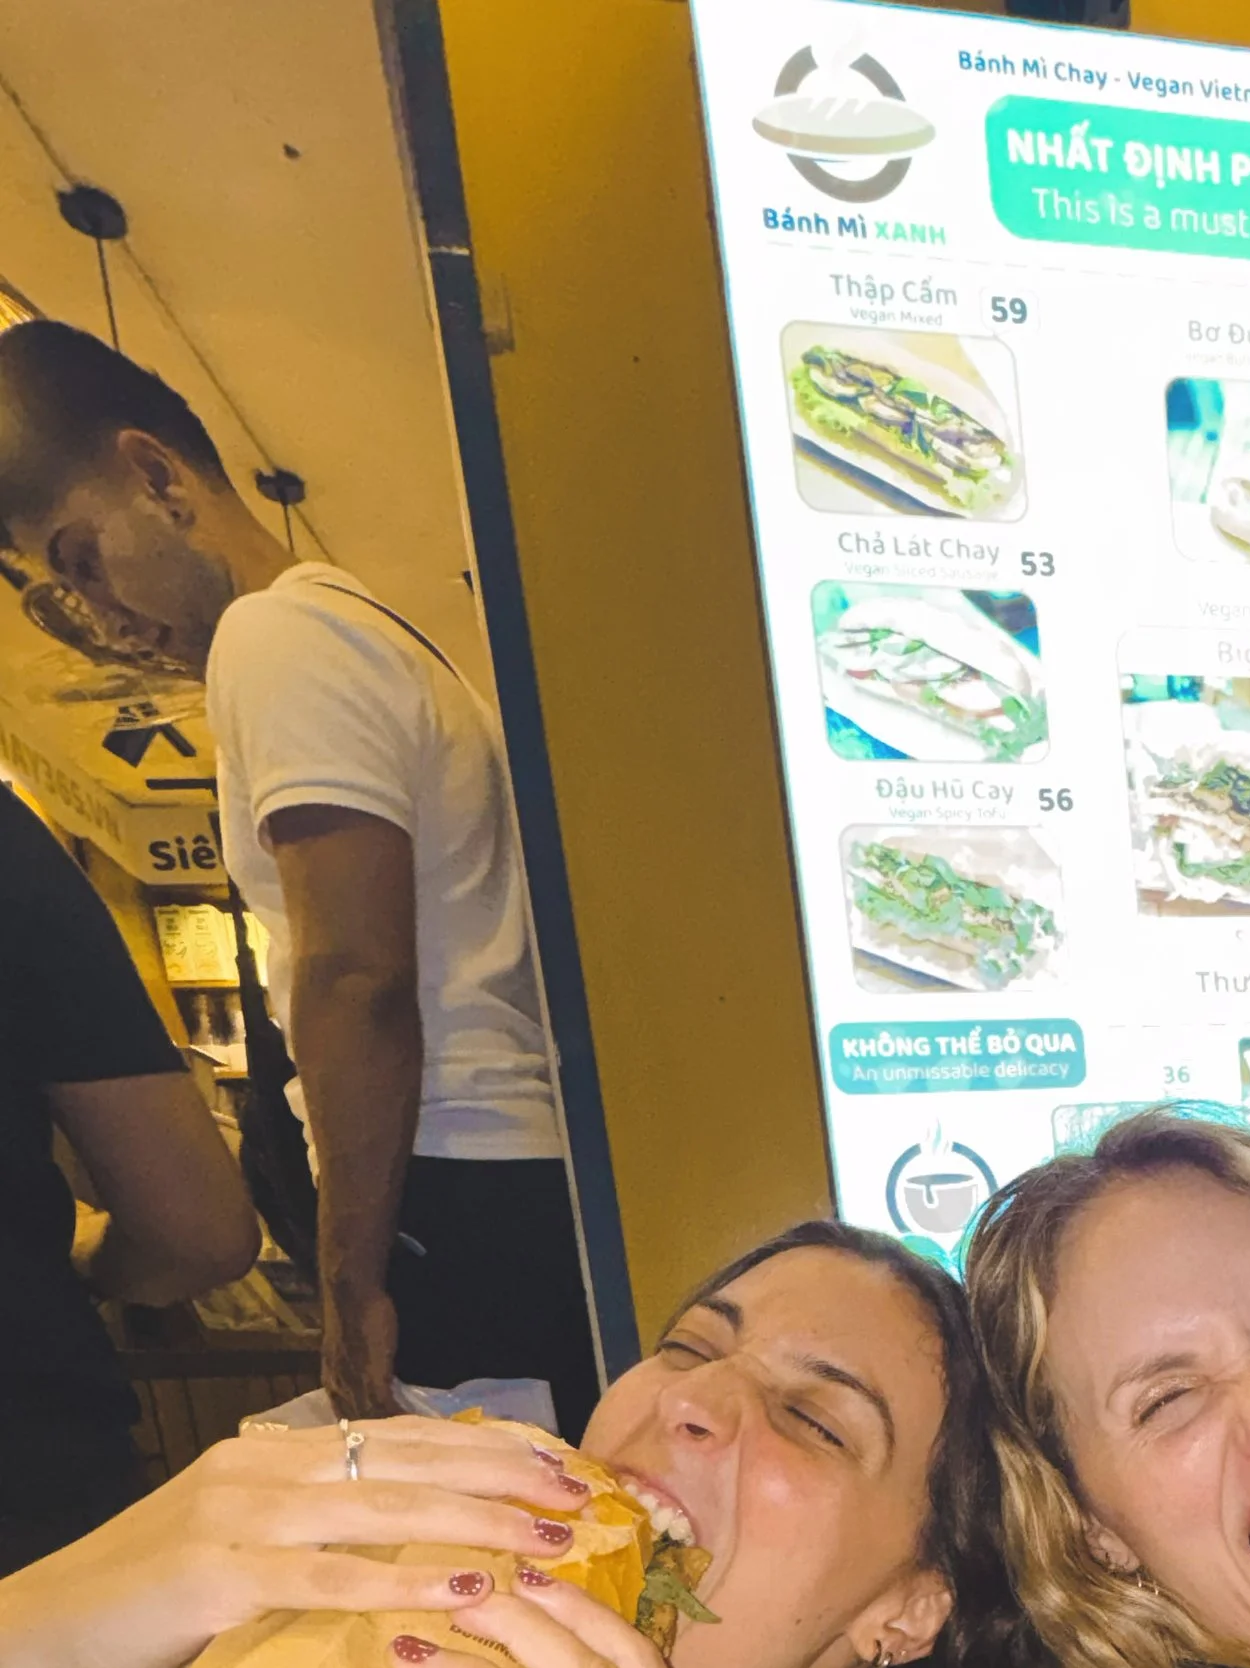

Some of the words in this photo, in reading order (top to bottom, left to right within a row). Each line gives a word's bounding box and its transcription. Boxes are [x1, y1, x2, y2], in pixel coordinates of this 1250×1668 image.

[958, 49, 1017, 81] Bánh
[1022, 57, 1048, 81] Mì
[1054, 61, 1107, 91] Chay
[1127, 69, 1194, 100] Vegan
[1007, 121, 1113, 171] NHẤT
[1127, 141, 1220, 189] ĐỊNH
[1030, 186, 1100, 224] This
[1108, 193, 1134, 225] is
[1141, 203, 1161, 228] a
[761, 207, 830, 237] Bánh
[837, 211, 868, 240] Mì
[873, 221, 948, 247] XANH
[829, 272, 896, 309] Thập
[849, 306, 896, 326] Vegan
[900, 310, 943, 328] Mixed
[989, 296, 1029, 325] 59
[1187, 319, 1222, 345] Bơ
[837, 531, 886, 556] Chả
[892, 534, 932, 557] Lát
[939, 538, 1000, 567] Chay
[1020, 550, 1056, 577] 53
[875, 776, 925, 803] Đậu
[971, 779, 1014, 805] Cay
[1037, 787, 1074, 812] 56
[889, 806, 931, 822] Vegan
[842, 1031, 930, 1057] KHÔNG
[935, 1025, 982, 1055] THỂ
[987, 1028, 1020, 1054] BỎ
[1025, 1033, 1076, 1056] QUA
[852, 1063, 877, 1081] An
[883, 1062, 990, 1081] unmissable
[995, 1061, 1069, 1080] delicacy
[1162, 1065, 1191, 1084] 36
